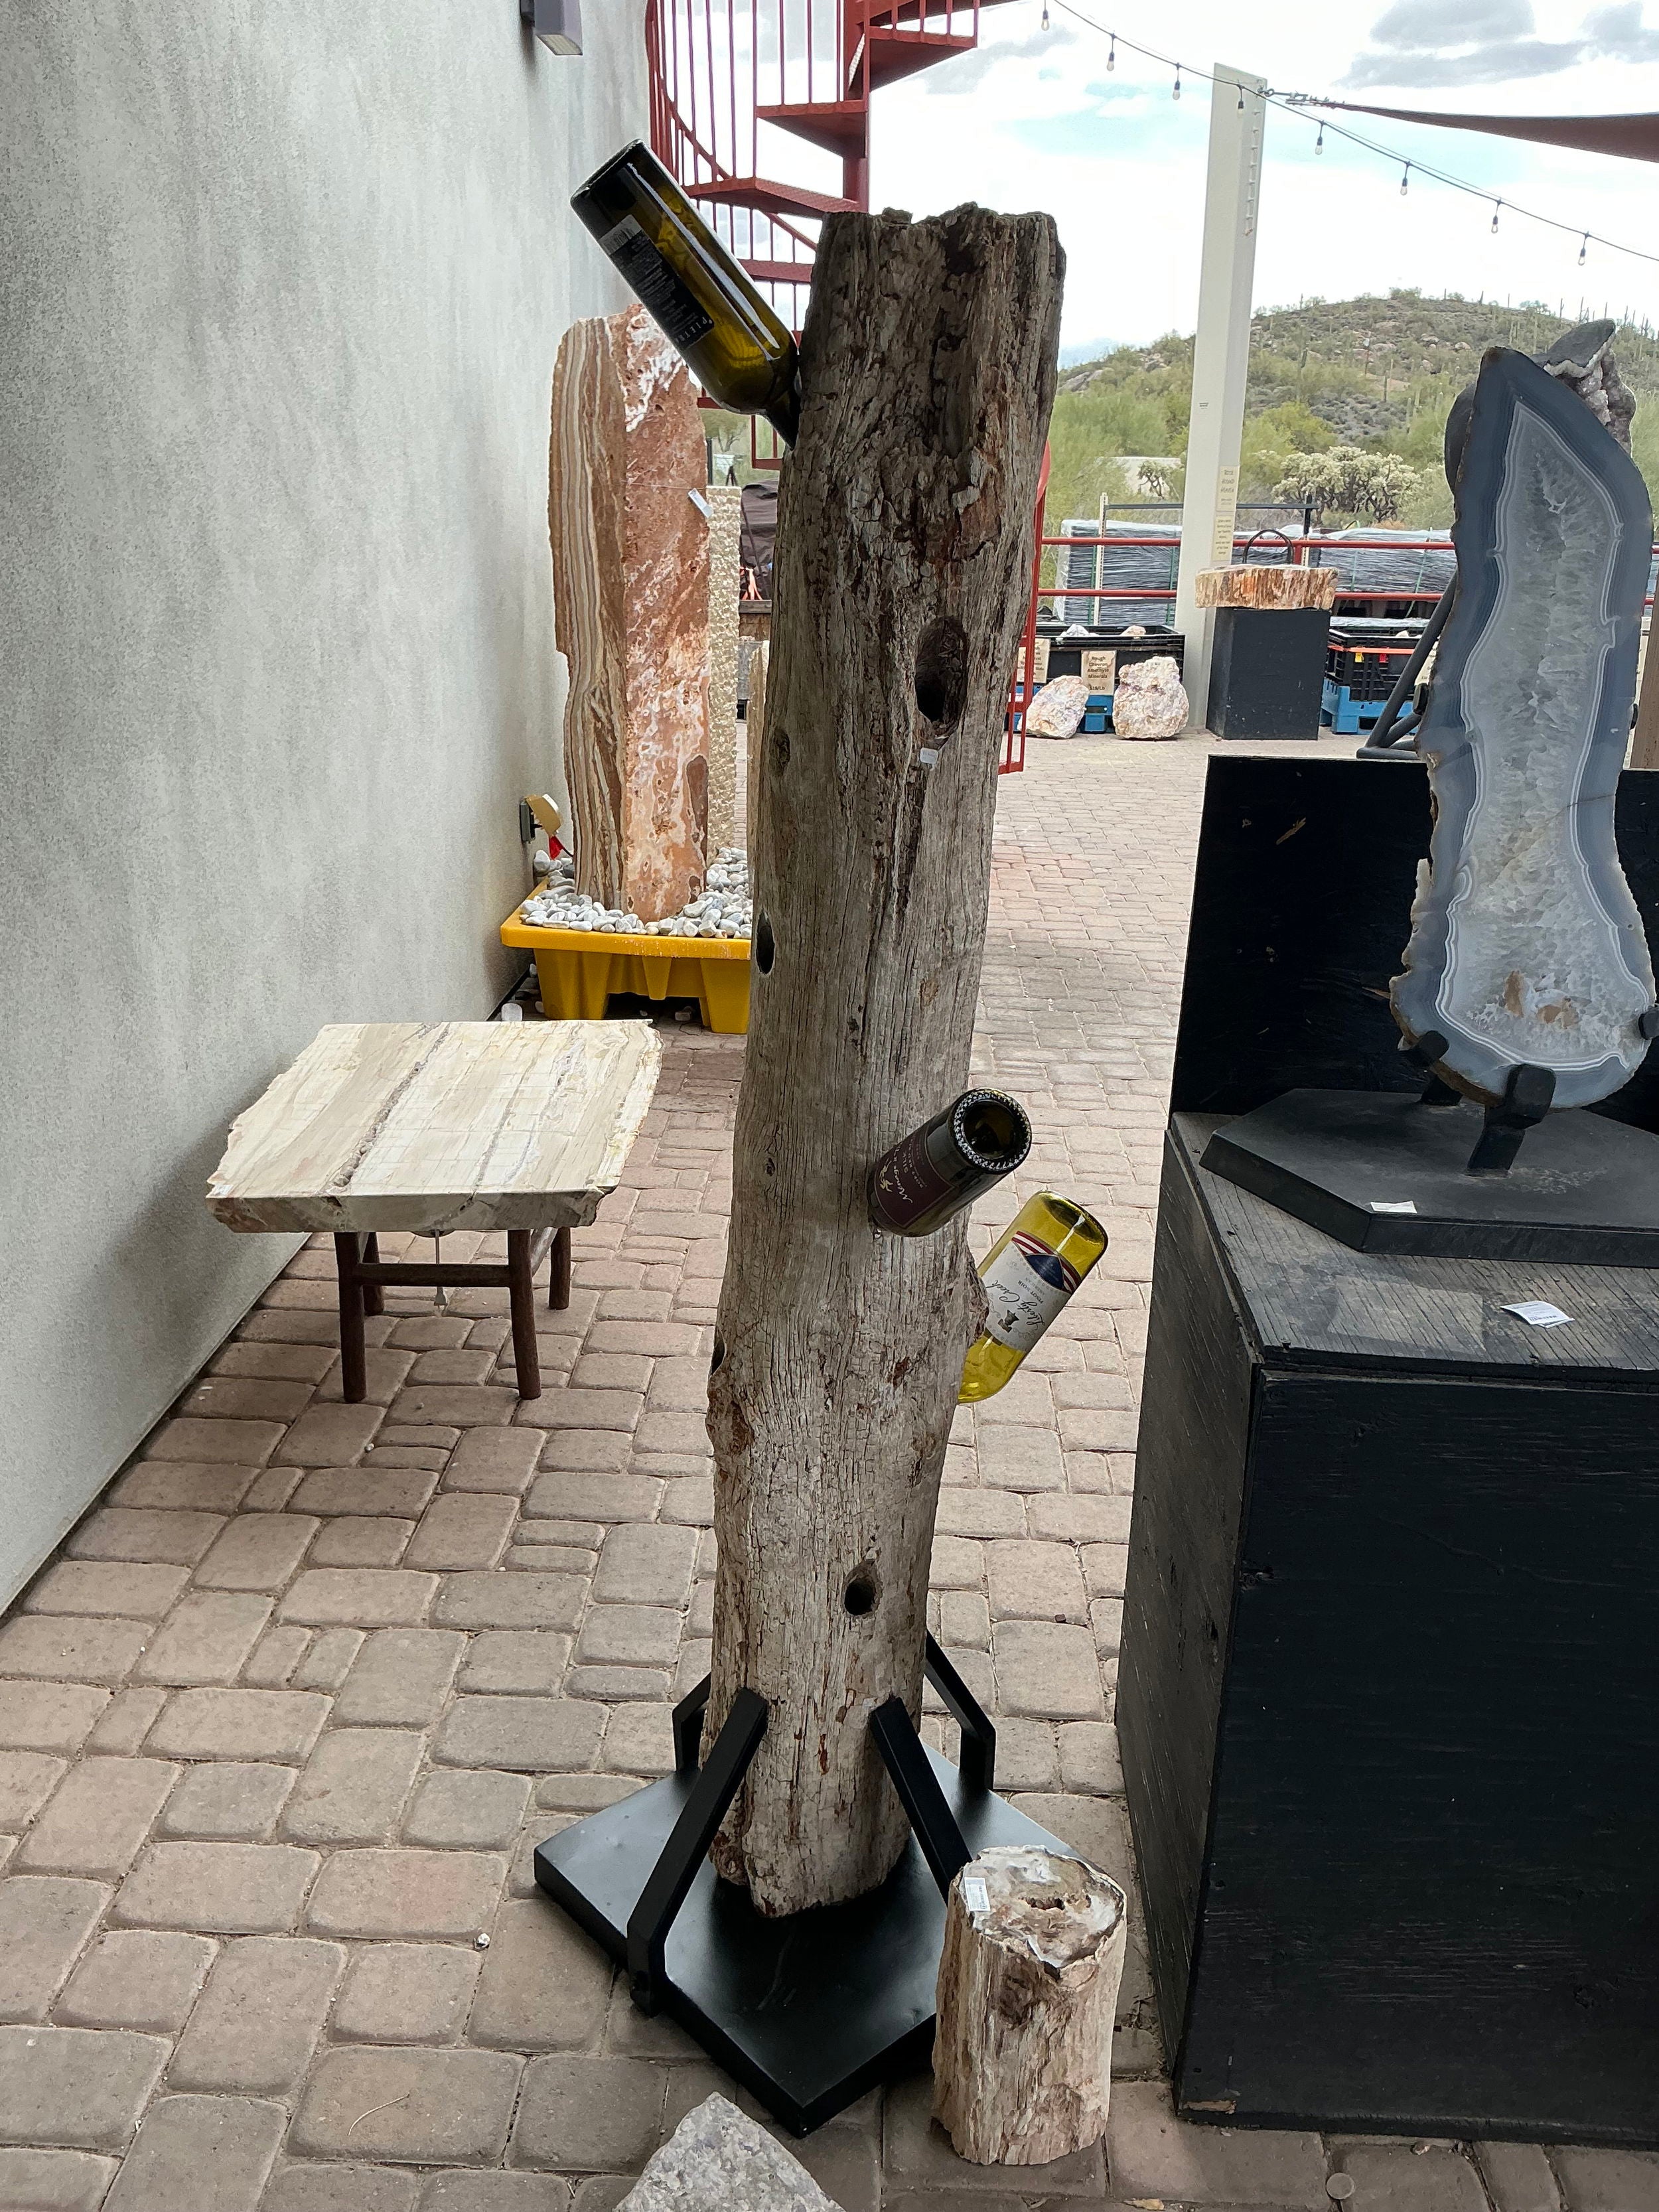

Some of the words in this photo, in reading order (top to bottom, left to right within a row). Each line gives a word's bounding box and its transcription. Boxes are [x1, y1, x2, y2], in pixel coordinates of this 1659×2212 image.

[985, 1280, 1020, 1303] Creek
[1017, 1280, 1029, 1291] NOIR
[1031, 1291, 1044, 1303] PINOT
[1017, 1300, 1045, 1330] Liberty
